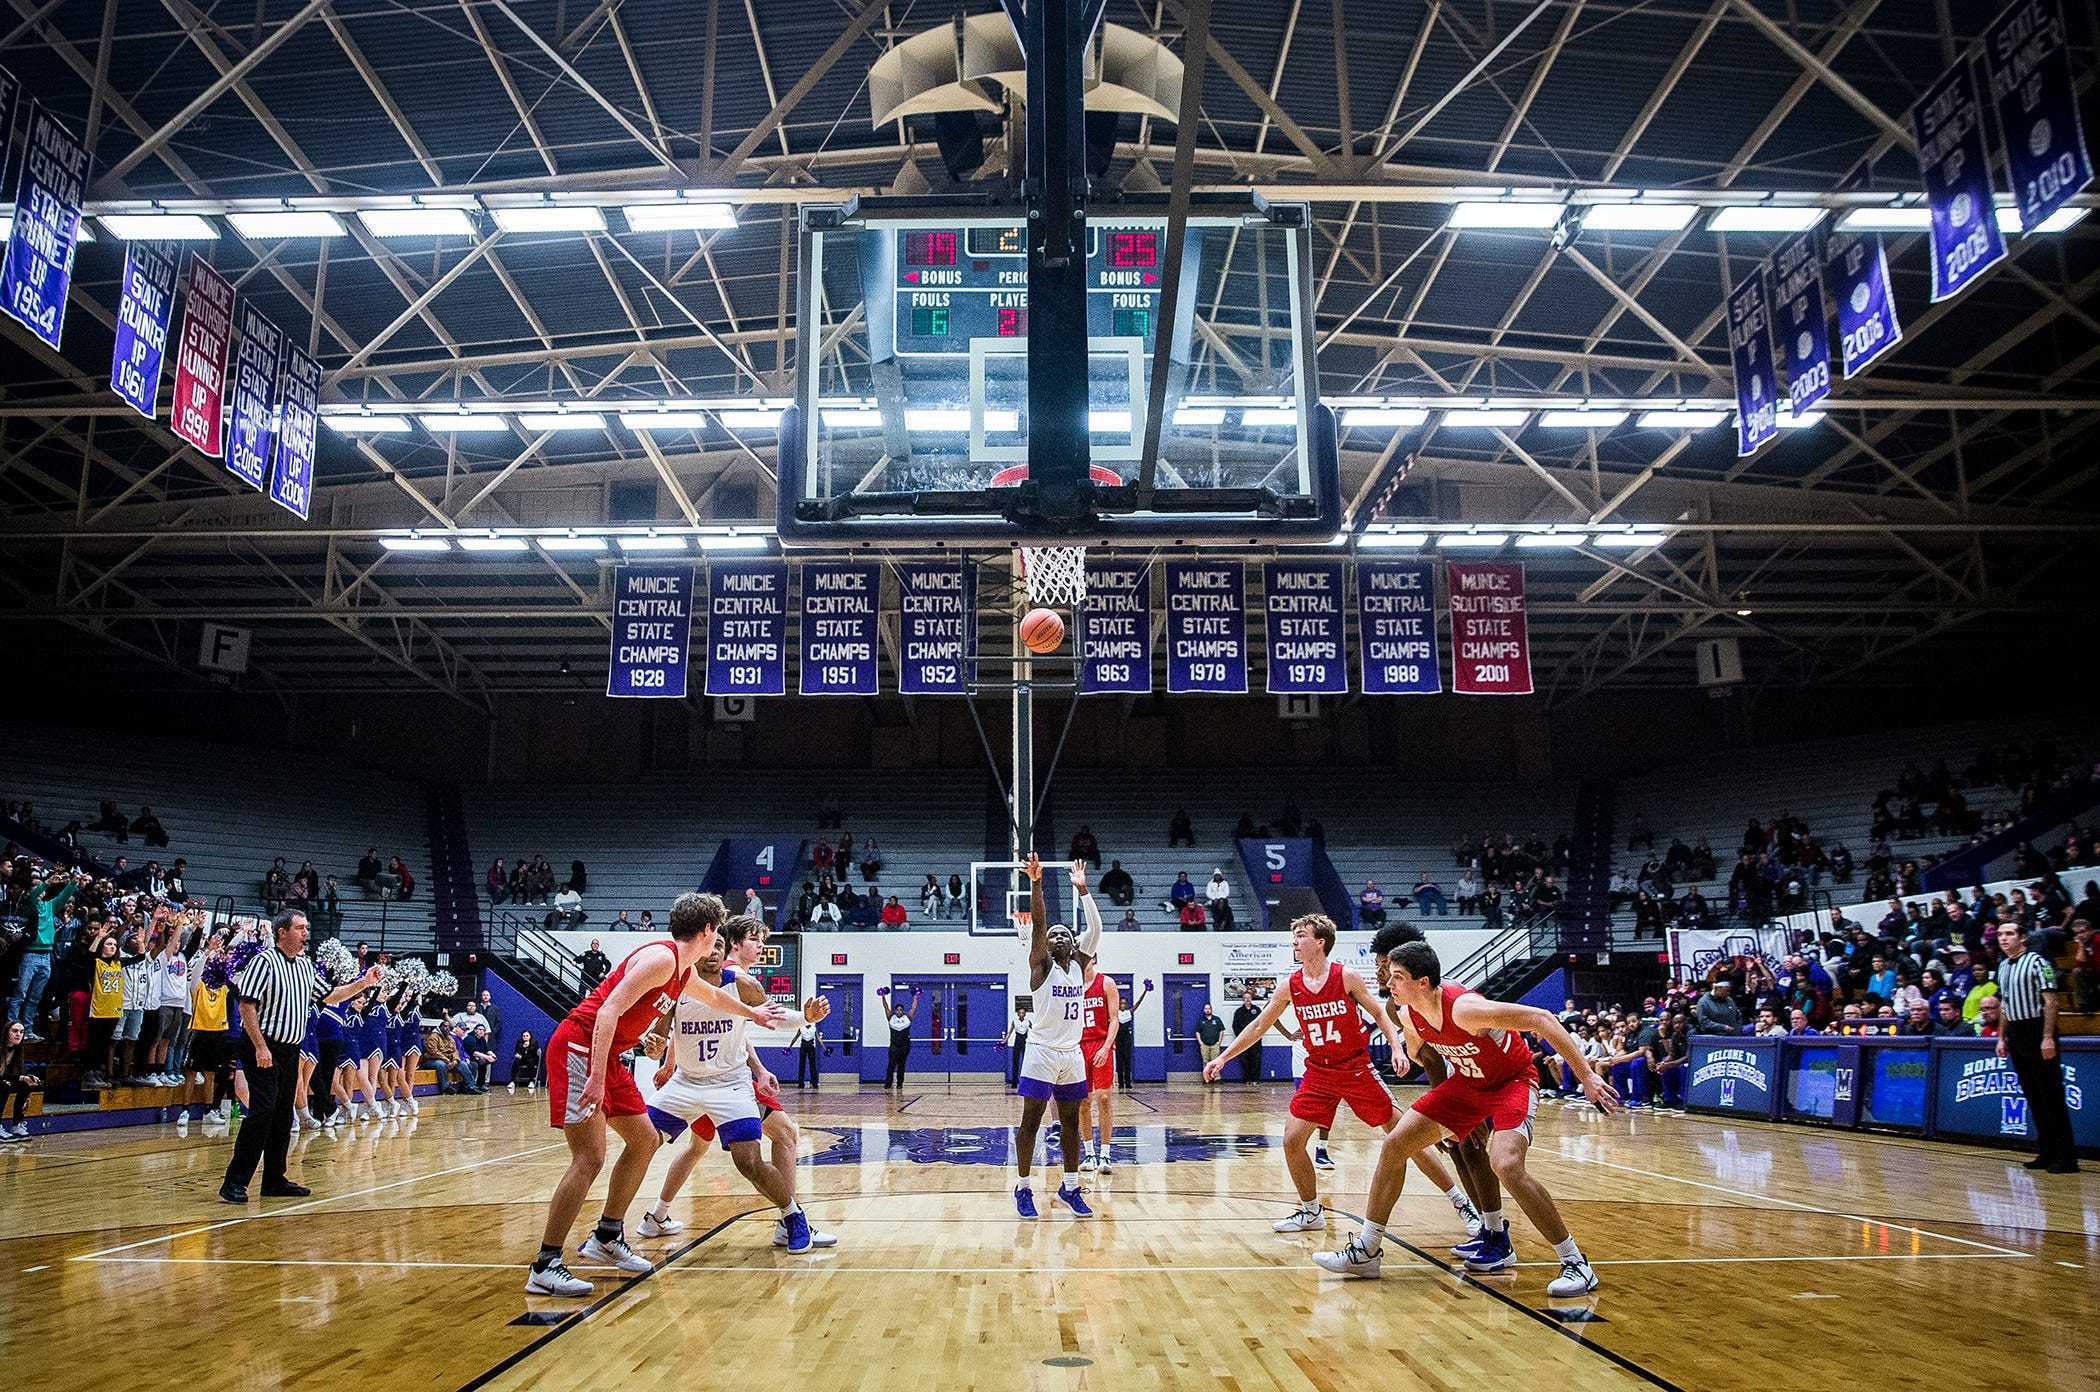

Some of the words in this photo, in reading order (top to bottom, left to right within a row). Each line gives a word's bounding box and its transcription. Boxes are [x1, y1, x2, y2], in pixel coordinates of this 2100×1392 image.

[2021, 71, 2042, 114] UP
[1923, 75, 1965, 136] STATE
[35, 114, 88, 180] MUNCIE
[1943, 148, 1965, 186] UP
[29, 145, 82, 215] CENTRAL
[2027, 150, 2077, 215] 2010
[31, 183, 75, 239] STATE
[15, 207, 74, 276] RUNNER
[928, 233, 955, 265] 19
[1115, 234, 1155, 266] 25
[30, 254, 48, 289] UP
[921, 271, 962, 285] BONUS
[999, 272, 1028, 284] PERI
[1100, 271, 1141, 286] BONUS
[131, 271, 163, 317] SATE
[194, 264, 230, 314] MUNCIE
[14, 280, 56, 334] 1954
[912, 293, 950, 307] FOULS
[990, 293, 1028, 307] PLAYE
[1113, 294, 1151, 308] FOULS
[187, 290, 230, 342] SOUTHSIDE
[1792, 296, 1809, 326] UP
[932, 310, 947, 335] 6
[1133, 311, 1148, 337] 7
[246, 310, 279, 355] MUNCIE
[188, 322, 221, 366] STATE
[1747, 339, 1758, 366] P
[240, 335, 274, 382] CENTRAL
[183, 343, 220, 396] RUNNER
[119, 360, 145, 403] 1960
[241, 364, 269, 404] STATE
[1790, 360, 1829, 405] 2003
[192, 382, 207, 410] UP
[181, 405, 209, 445] 1999
[287, 401, 313, 439] STATE
[246, 421, 257, 448] UP
[233, 443, 263, 480] 2005
[289, 453, 303, 479] UP
[628, 576, 680, 594] MUNCIE
[723, 574, 775, 592] MUNCIE
[815, 573, 867, 591] MUNCIE
[912, 573, 962, 589] MUNCIE
[1085, 572, 1137, 588] MUNCIE
[1179, 573, 1231, 589] MUNCIE
[1277, 573, 1330, 589] MUNCIE
[1371, 573, 1421, 590] MUNCIE
[1461, 573, 1510, 591] MUNCIE
[619, 598, 685, 618] CENTRAL
[713, 597, 781, 615] CENTRAL
[806, 597, 874, 614] CENTRAL
[903, 596, 962, 612] CENTRA
[1171, 595, 1240, 612] CENTRAL
[1269, 596, 1338, 613] CENTRAL
[1364, 596, 1431, 613] CENTRAL
[1452, 596, 1524, 613] SOUTHSIDE
[627, 622, 674, 641] STATE
[723, 620, 771, 638] STATE
[816, 620, 862, 636] STATE
[914, 619, 962, 636] STATE
[1089, 618, 1135, 635] STATE
[1183, 618, 1230, 635] STATE
[1280, 619, 1329, 636] STATE
[1375, 618, 1423, 636] STATE
[1466, 619, 1511, 636] STATE
[211, 629, 239, 664] F
[619, 646, 679, 663] CHAMPS
[716, 643, 777, 661] CHAMPS
[810, 643, 870, 661] CHAMPS
[1084, 641, 1141, 658] CHAMPS
[1177, 641, 1238, 658] CHAMPS
[1275, 641, 1336, 659] CHAMPS
[1369, 641, 1430, 659] CHAMPS
[1462, 642, 1519, 659] CHAMPS
[630, 669, 665, 687] 1928
[729, 666, 762, 685] 1931
[822, 666, 857, 684] 1951
[921, 666, 956, 683] 1952
[1096, 664, 1130, 682] 1963
[1189, 663, 1226, 681] 1978
[1288, 665, 1325, 682] 1979
[1384, 665, 1419, 683] 1988
[1475, 665, 1509, 682] 2001
[723, 697, 745, 715] G
[756, 846, 774, 871] 4
[1265, 844, 1286, 870] 5
[834, 954, 846, 964] EXIT
[946, 953, 959, 963] EXIT
[103, 979, 120, 993] 24
[771, 976, 791, 993] 25
[1052, 985, 1083, 998] BEARCAT
[766, 993, 796, 1002] ISITOR
[1083, 997, 1104, 1009] HERS
[1064, 1002, 1079, 1020] 13
[1296, 1000, 1347, 1020] FISHERS
[681, 1020, 733, 1035] BEARCATS
[1308, 1020, 1342, 1047] 24
[698, 1039, 720, 1062] 15
[1707, 1049, 1744, 1063] WELCOME
[1746, 1052, 1757, 1066] TO
[1963, 1056, 2007, 1076] HOME
[1836, 1069, 1853, 1092] M
[1720, 1079, 1736, 1101] M
[2001, 1096, 2028, 1124] M
